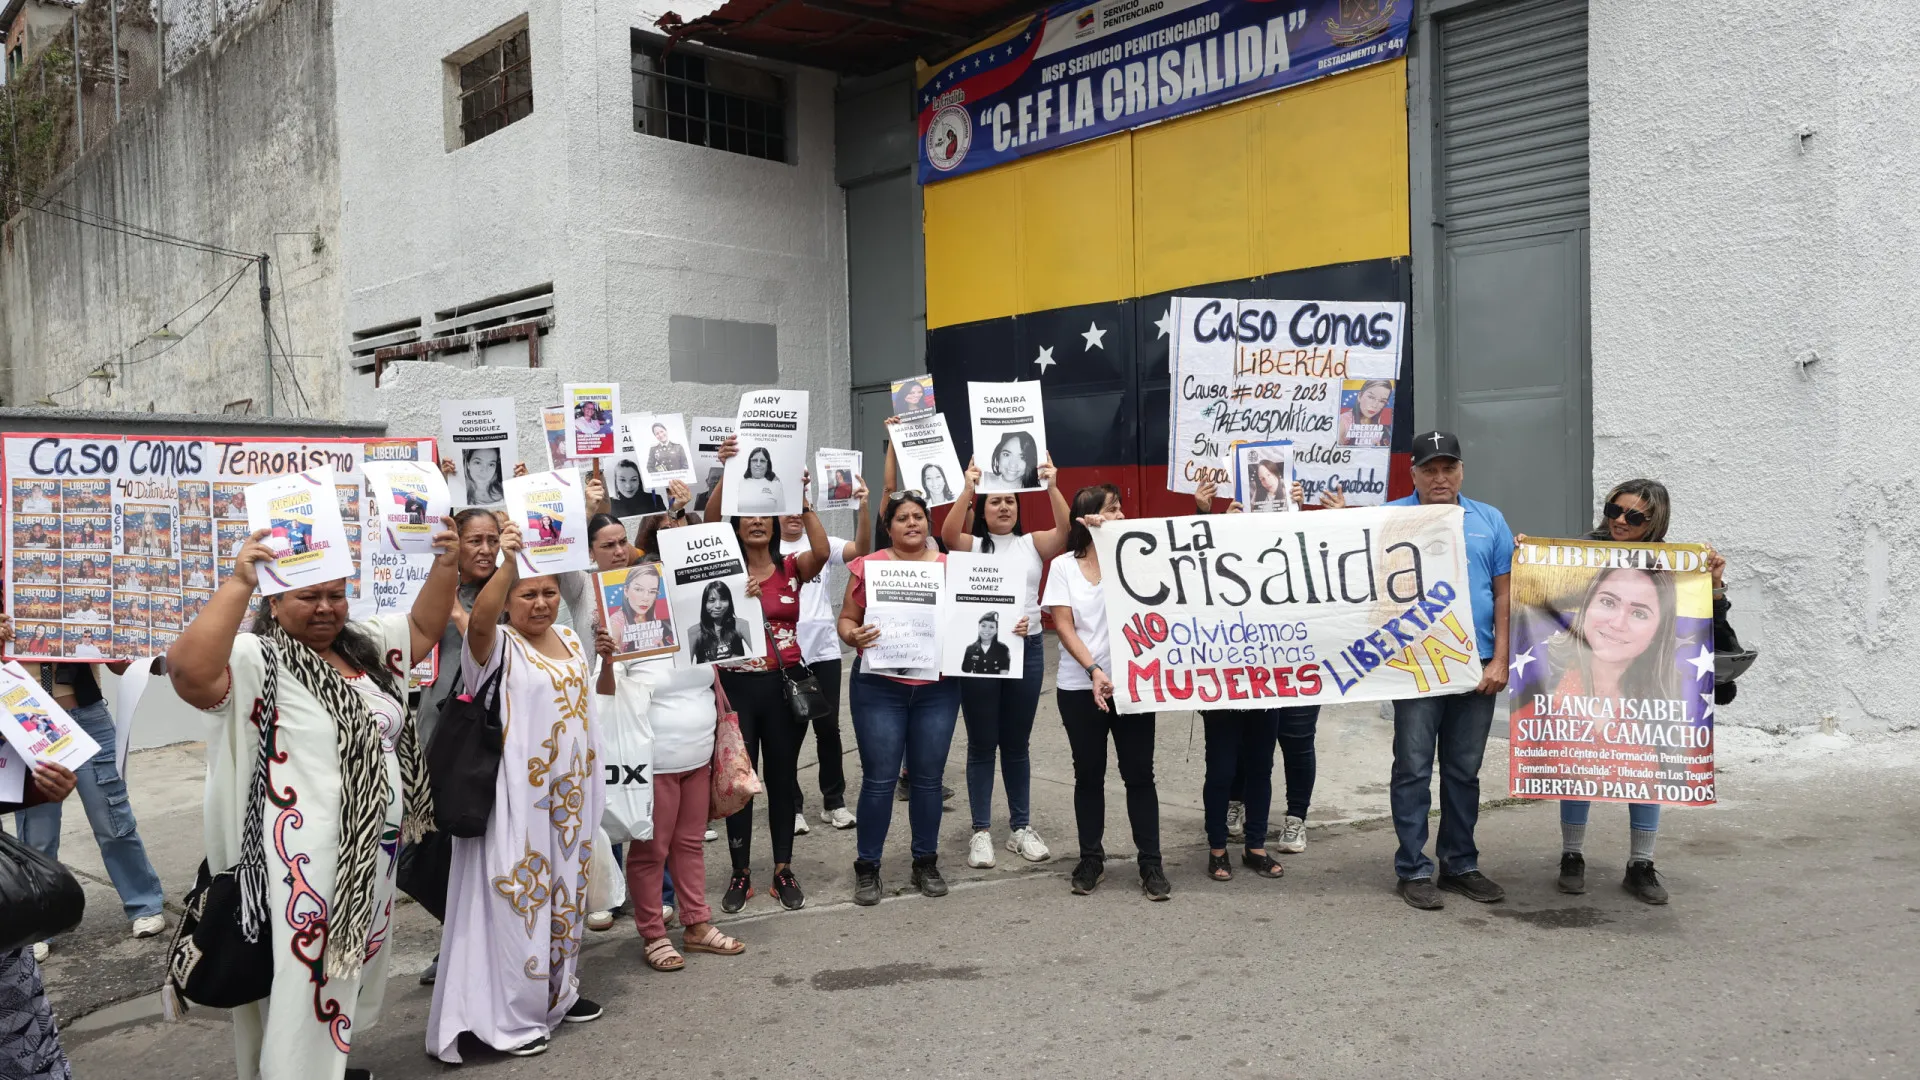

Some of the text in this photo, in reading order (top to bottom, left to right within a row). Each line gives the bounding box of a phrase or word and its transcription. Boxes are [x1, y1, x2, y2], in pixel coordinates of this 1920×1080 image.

[1103, 0, 1139, 18] SERVICIO
[1103, 1, 1164, 29] PENITENCIARIO
[1042, 12, 1220, 84] MSP SERVICIO PENITENCIARIO
[1318, 45, 1376, 69] DESTACAMENTO
[1388, 38, 1403, 50] 441
[1059, 77, 1095, 134] LA
[1194, 301, 1393, 349] Caso Conas
[1183, 375, 1228, 400] Causa
[753, 396, 781, 404] MARY
[983, 396, 1026, 404] SAMAIRA
[462, 409, 493, 417] GÉNESIS
[742, 410, 798, 419] RODRIGUEZ
[700, 425, 723, 433] ROSA
[904, 430, 936, 438] TABOSKY
[915, 422, 942, 430] DELGADO
[29, 437, 118, 475] Caso
[129, 440, 203, 478] Conas
[372, 446, 411, 459] LIBERTAD
[116, 478, 133, 497] 40
[1166, 519, 1215, 552] La
[400, 553, 407, 565] 3
[685, 549, 730, 564] ACOSTA
[1517, 543, 1709, 573] ¡LIBERTAD!
[373, 567, 392, 581] PNB
[676, 560, 739, 576] DETENIDA INJUSTAMENTE
[880, 569, 917, 577] DIANA
[1115, 527, 1427, 607] Crisálida
[399, 582, 407, 595] 2
[872, 580, 940, 590] MAGALLANES
[624, 620, 661, 633] LIBERTAD
[1123, 612, 1308, 657] NO olvidemos
[634, 640, 654, 649] LEAL
[1321, 580, 1457, 696] LIBERTAD
[1167, 647, 1184, 665] a
[1385, 610, 1473, 692] YA!
[1127, 658, 1323, 702] MUJERES
[1533, 693, 1694, 723] BLANCA ISABEL
[1517, 719, 1711, 749] SUAREZ CAMACHO
[1514, 748, 1548, 758] Recluida
[1560, 748, 1568, 758] el
[1569, 749, 1598, 760] Centro
[1599, 750, 1610, 759] de
[1611, 750, 1658, 763] Formación
[1660, 752, 1713, 765] Penitenciari
[1518, 763, 1558, 774] Femenino
[1618, 767, 1653, 779] Ubicado
[1655, 771, 1666, 779] en
[1668, 769, 1684, 781] Los
[1686, 770, 1713, 783] Teques
[1514, 778, 1714, 802] LIBERTAD PARA TODOS
